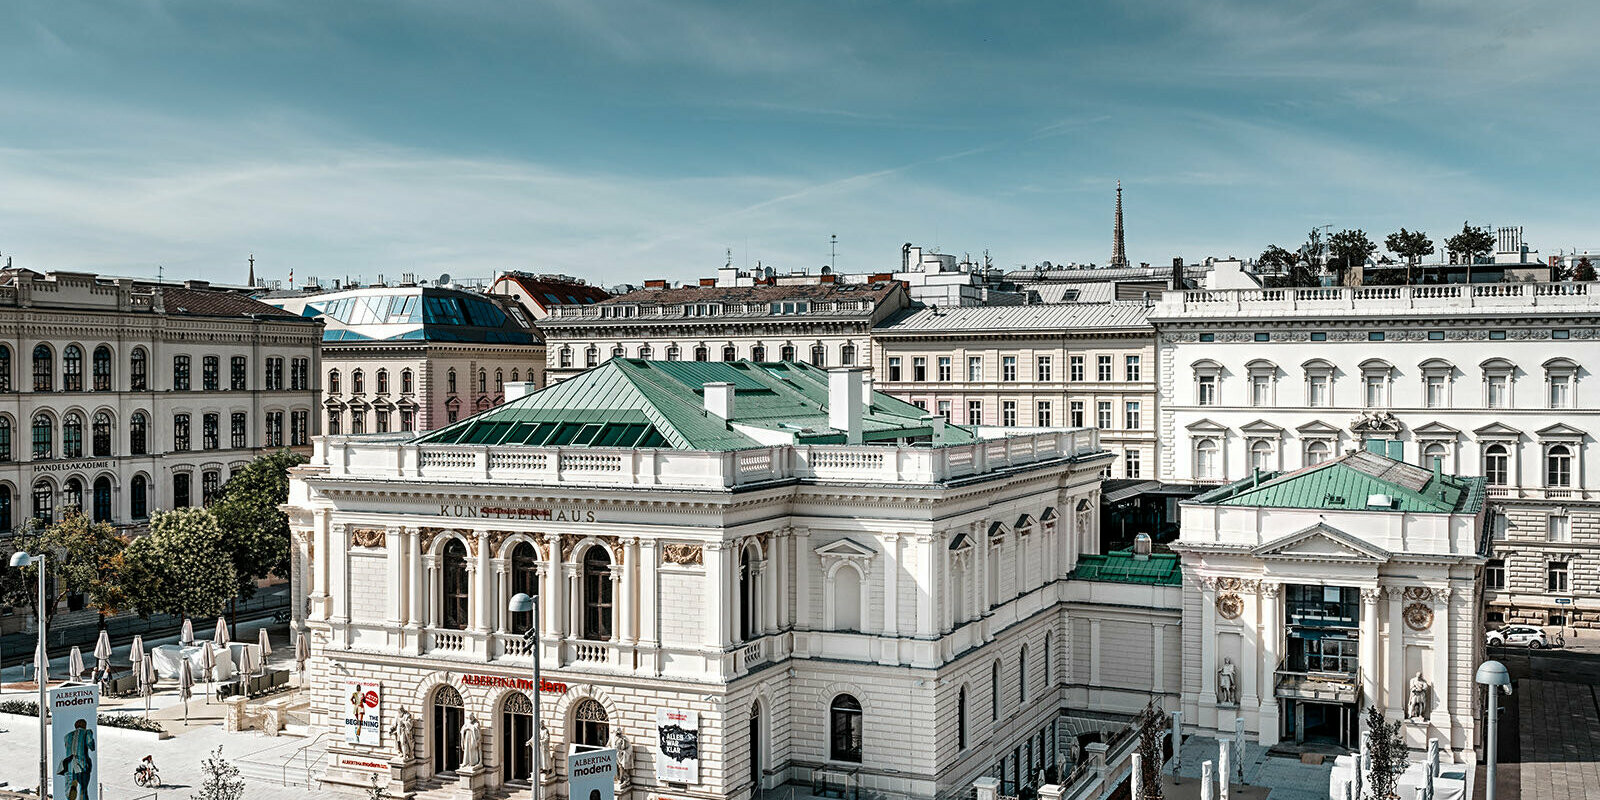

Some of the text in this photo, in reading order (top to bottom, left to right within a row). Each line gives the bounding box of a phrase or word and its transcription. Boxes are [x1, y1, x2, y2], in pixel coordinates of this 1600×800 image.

[33, 461, 108, 472] HANDELSAKADEMIE
[56, 690, 93, 699] ALBERTINA
[56, 697, 94, 707] modern
[666, 733, 684, 741] ALLES
[574, 755, 612, 767] ALBERTINA
[574, 764, 612, 777] modern
